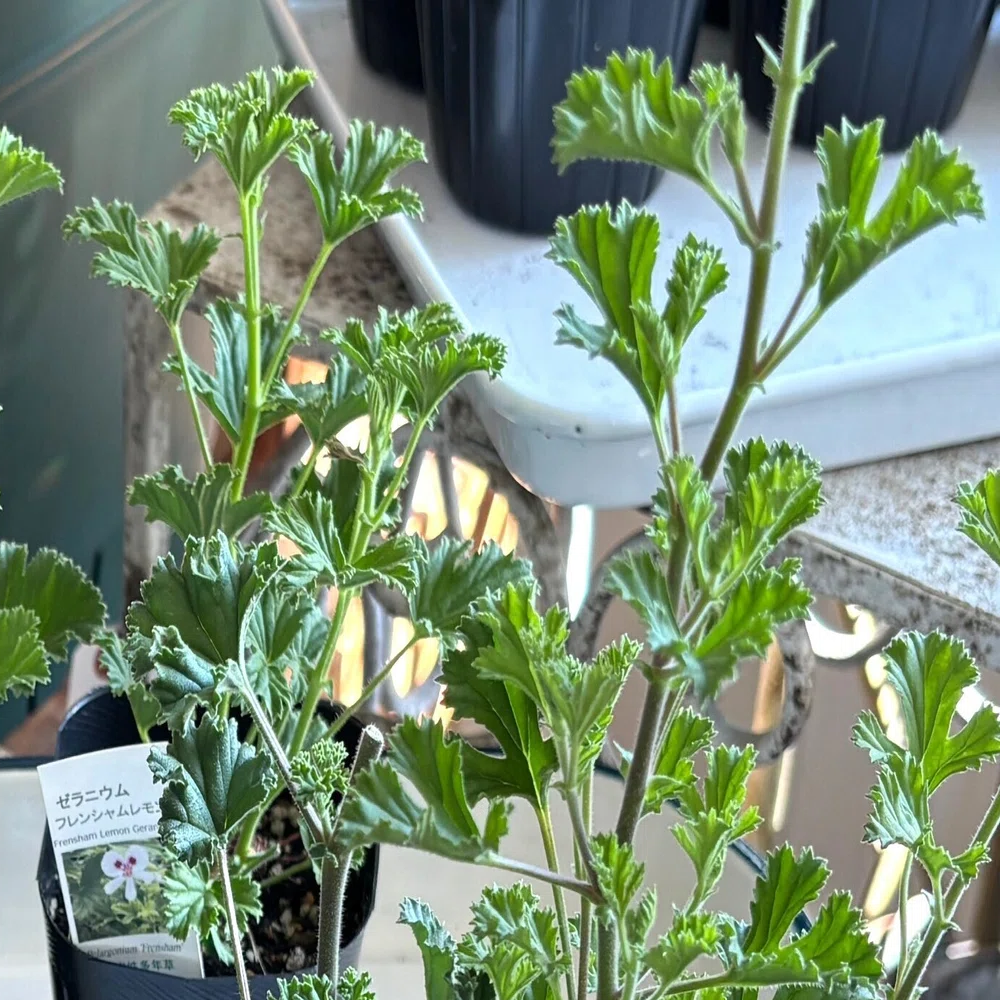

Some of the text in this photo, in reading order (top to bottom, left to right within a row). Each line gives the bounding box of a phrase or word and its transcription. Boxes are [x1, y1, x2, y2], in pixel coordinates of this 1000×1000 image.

[56, 783, 130, 809] ゼラニウム
[53, 832, 98, 848] Frensham
[99, 825, 131, 839] Lemon
